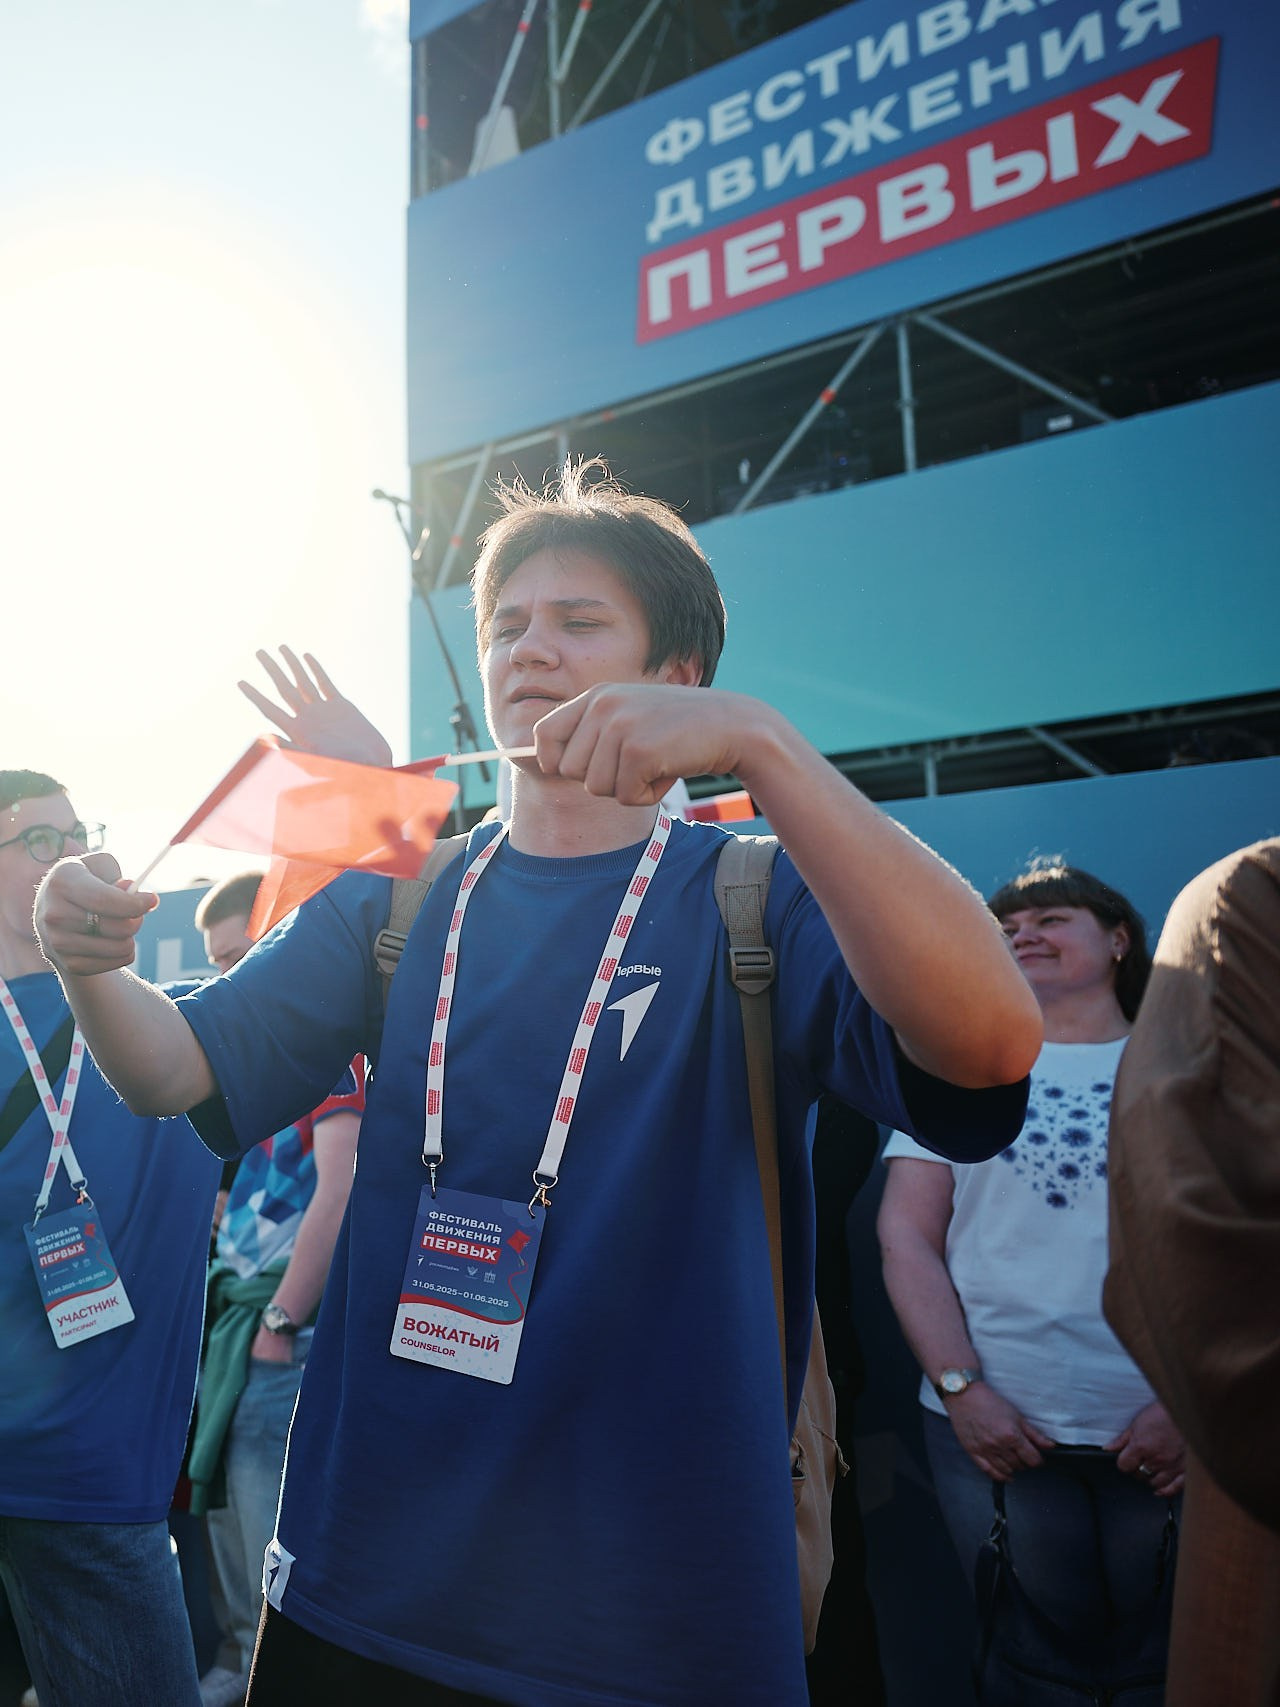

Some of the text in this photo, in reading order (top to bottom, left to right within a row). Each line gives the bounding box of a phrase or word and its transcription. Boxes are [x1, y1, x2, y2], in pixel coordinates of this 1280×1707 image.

[645, 0, 1058, 166] ФЕСТИВА
[645, 0, 1183, 242] ДВИЖЕНИЯ
[647, 68, 1191, 325] ПЕРВЫХ
[426, 1222, 501, 1245] ДВИЖЕНИЯ
[429, 1211, 503, 1233] ФЕСТИВАЛЬ
[35, 1226, 80, 1245] ФЕСТИВАЛЬ
[37, 1233, 82, 1255] ДВИЖЕНИЯ
[423, 1235, 497, 1261] ПЕРВЫХ
[39, 1243, 85, 1267] ПЕРВЫХ
[56, 1296, 120, 1328] УЧАСТНИК
[400, 1337, 456, 1357] COUNSELOR
[403, 1317, 500, 1353] ВОЖАТЫЙ
